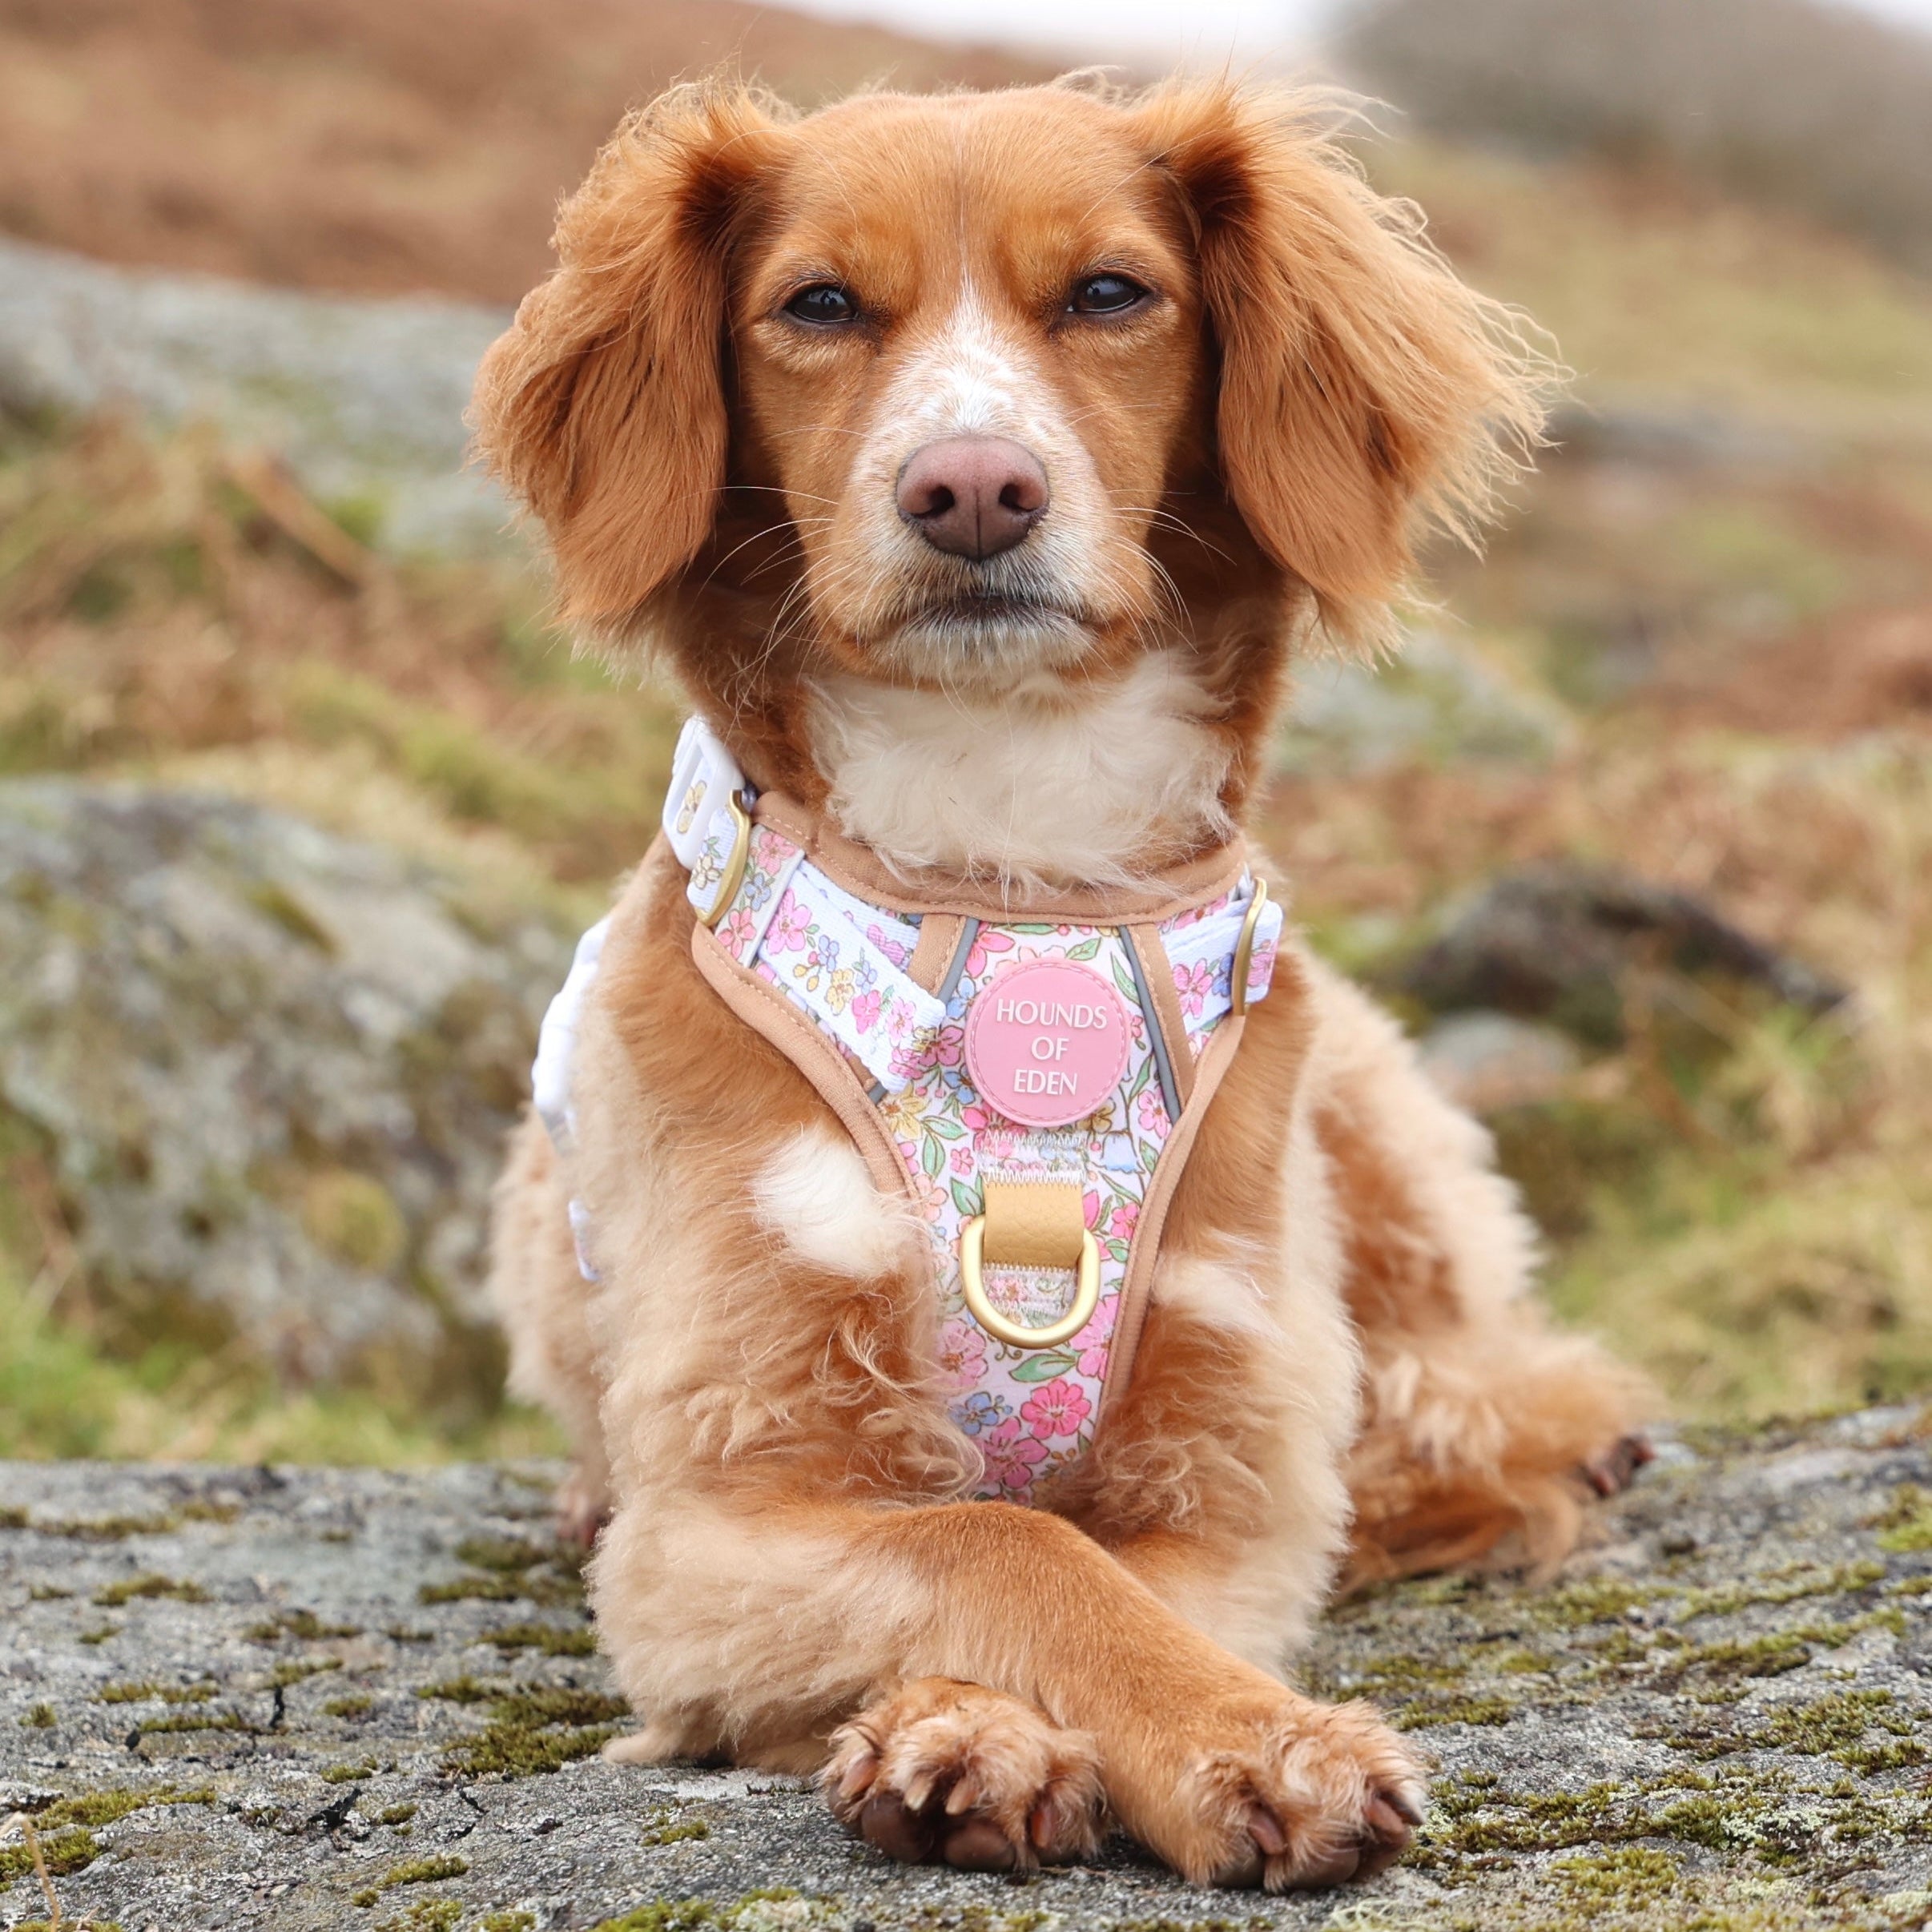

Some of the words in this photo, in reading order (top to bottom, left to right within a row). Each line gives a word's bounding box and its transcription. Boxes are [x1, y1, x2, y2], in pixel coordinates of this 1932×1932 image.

[996, 999, 1107, 1029] HOUNDS
[1031, 1036, 1069, 1061] OF
[1013, 1069, 1077, 1096] EDEN
